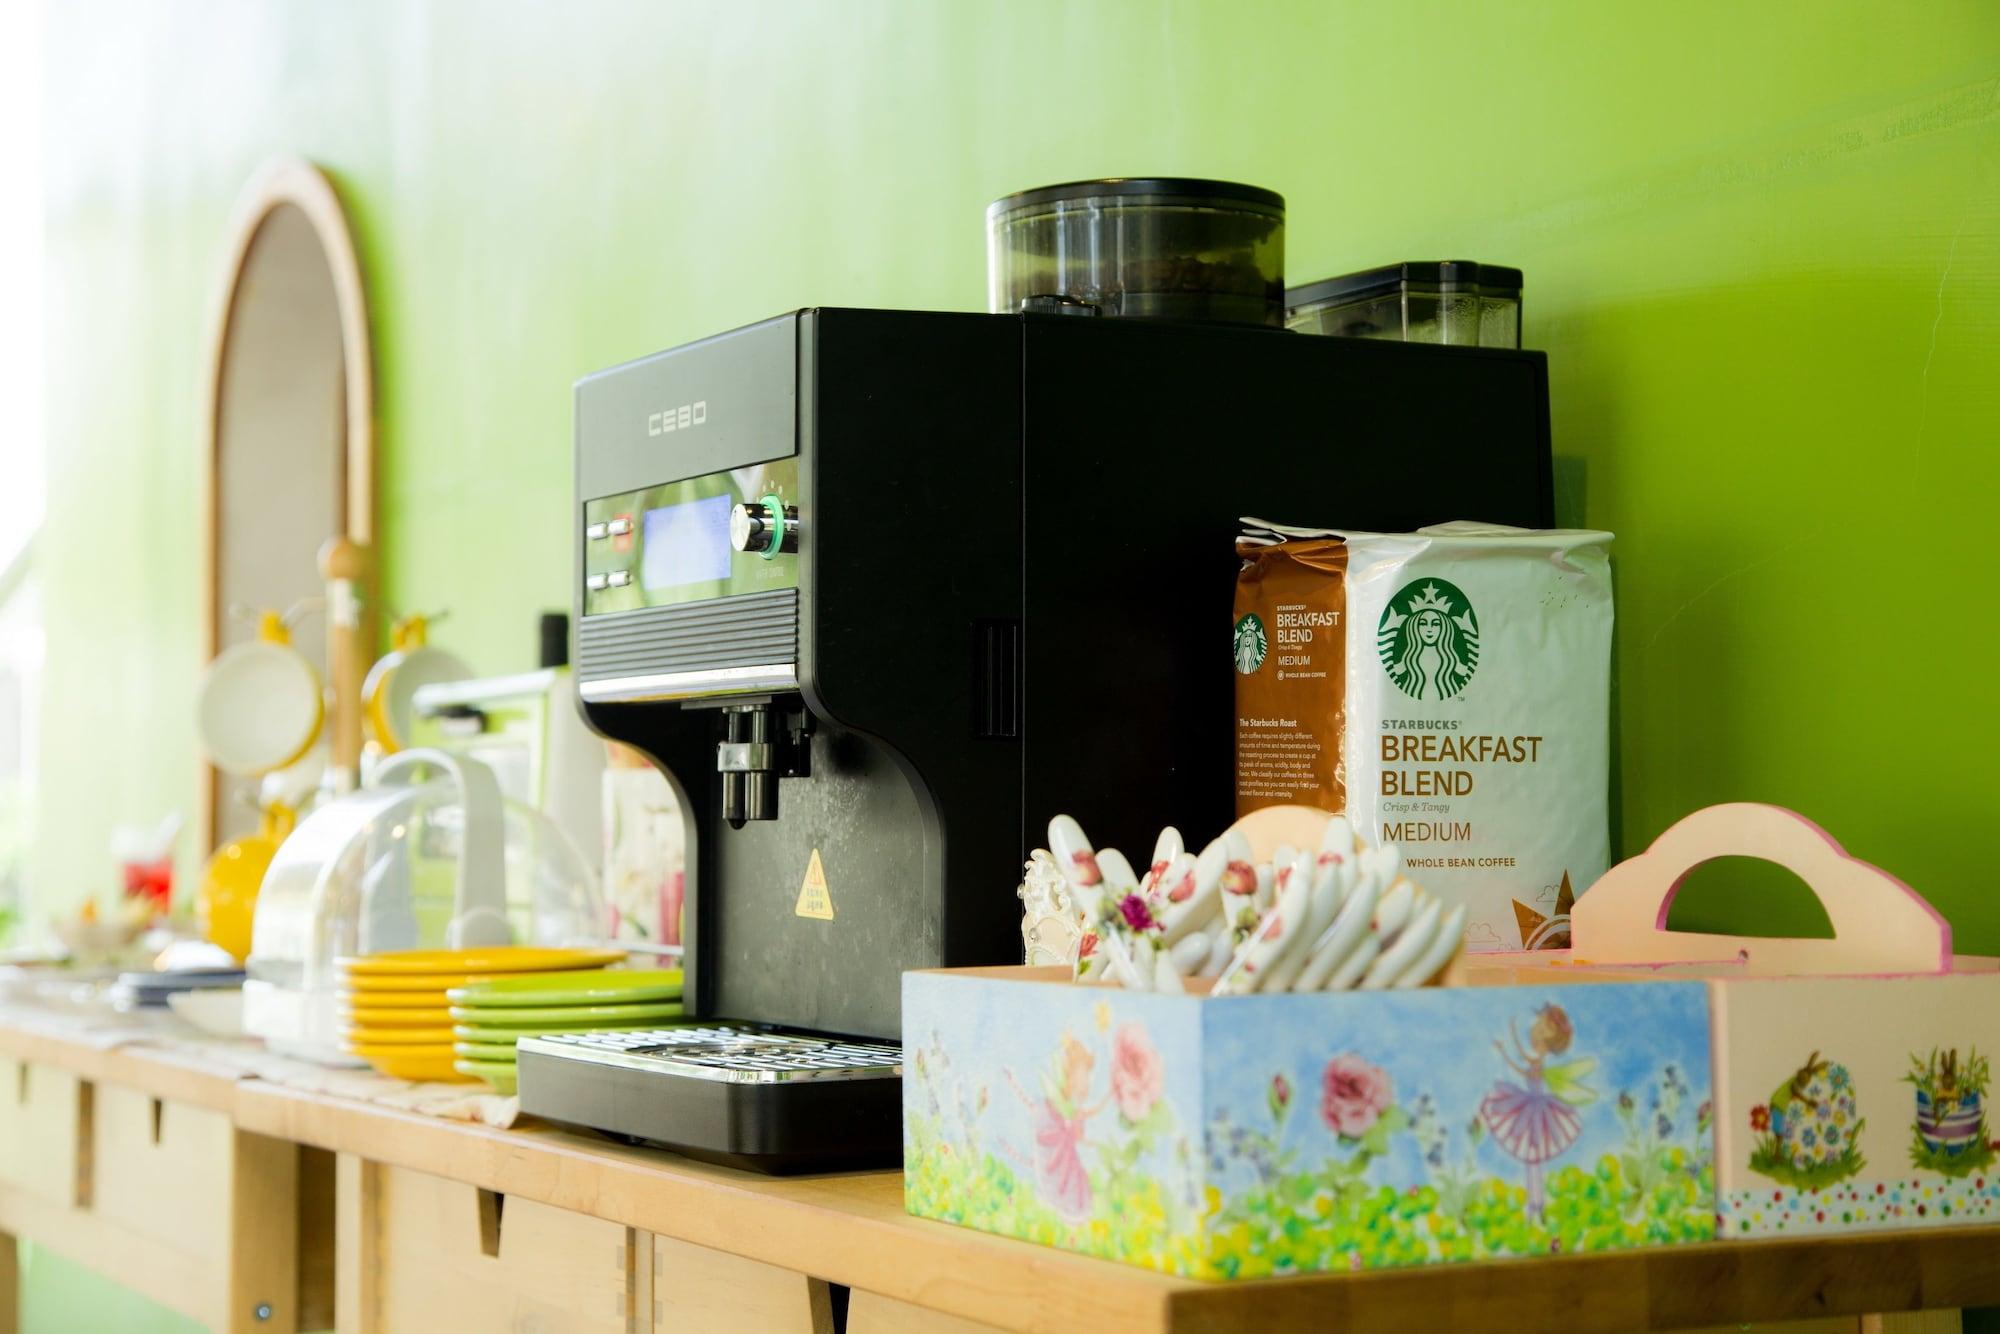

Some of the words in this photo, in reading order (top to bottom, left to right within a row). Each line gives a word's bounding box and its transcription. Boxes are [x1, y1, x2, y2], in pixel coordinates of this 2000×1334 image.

[1277, 612, 1340, 627] BREAKFAST
[1277, 629, 1313, 643] BLEND
[1278, 656, 1310, 666] MEDIUM
[1240, 718, 1249, 727] The
[1250, 718, 1278, 727] Starbucks
[1280, 719, 1297, 727] Roast
[1381, 735, 1542, 762] BREAKFAST
[1381, 771, 1473, 796] BLEND
[1383, 802, 1409, 813] Crisp
[1412, 803, 1418, 812] &
[1420, 802, 1450, 813] Tangy
[1383, 822, 1471, 841] MEDIUM
[1407, 858, 1444, 868] WHOLE
[1448, 858, 1475, 867] BEAN
[1478, 858, 1516, 867] COFFEE
